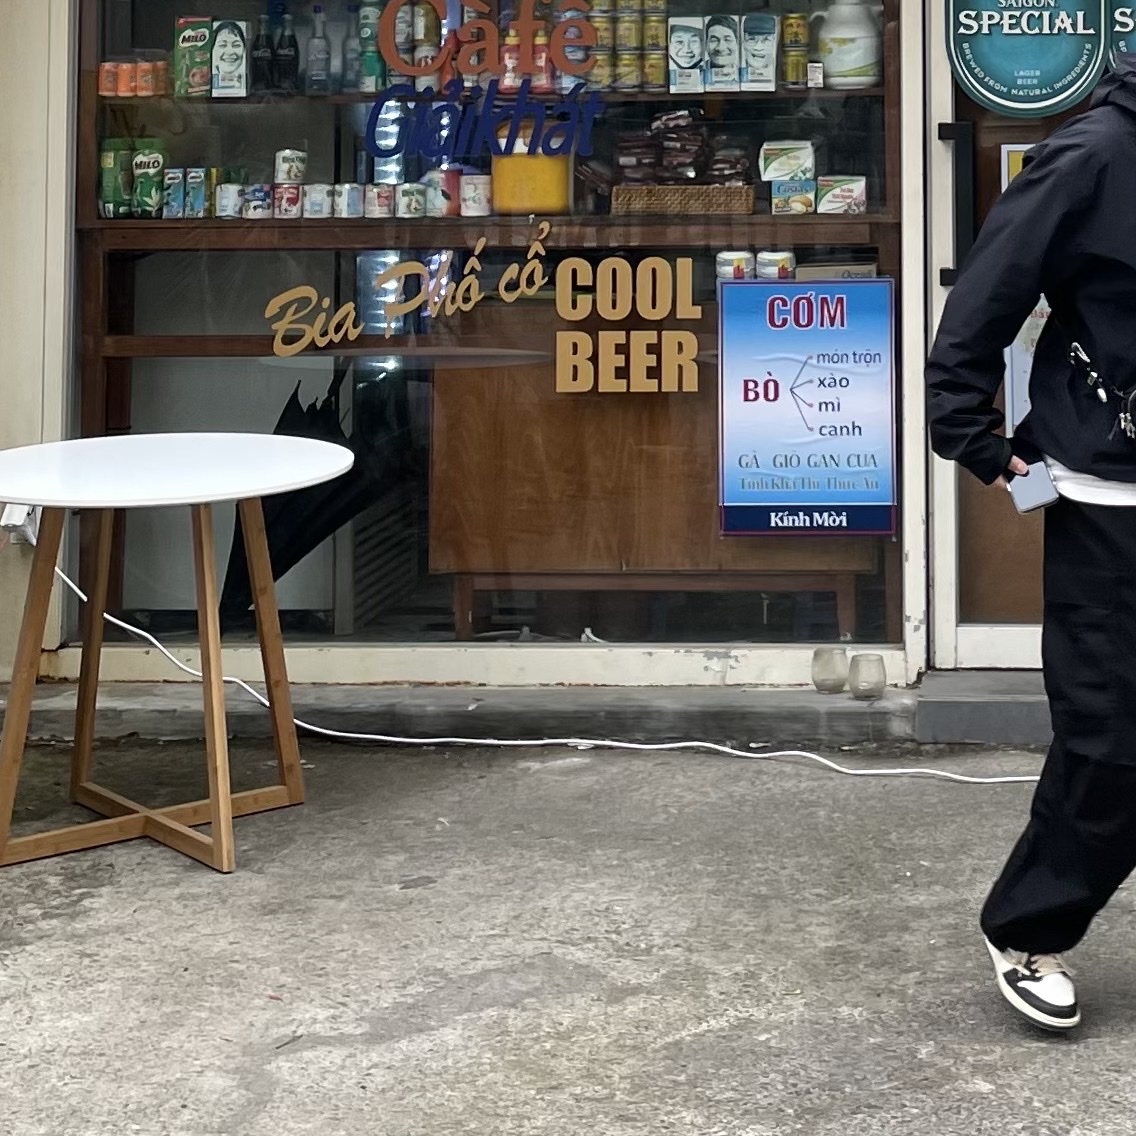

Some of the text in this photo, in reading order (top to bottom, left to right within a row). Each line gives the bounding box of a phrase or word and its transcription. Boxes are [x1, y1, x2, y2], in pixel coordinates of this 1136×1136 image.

[957, 10, 1097, 35] SPECIAL
[962, 42, 986, 79] BREWED
[984, 76, 1009, 94] FROM
[1010, 85, 1054, 97] NATURAL
[1053, 42, 1093, 91] INGREDIENTS
[1014, 69, 1041, 77] LAGER
[555, 256, 703, 321] COOL
[264, 285, 365, 357] Bia
[555, 330, 699, 393] BEER
[816, 349, 849, 364] món
[742, 371, 781, 403] BÒ
[817, 372, 850, 389] xào
[818, 397, 841, 413] mì
[818, 421, 863, 437] canh
[769, 510, 811, 528] Kính
